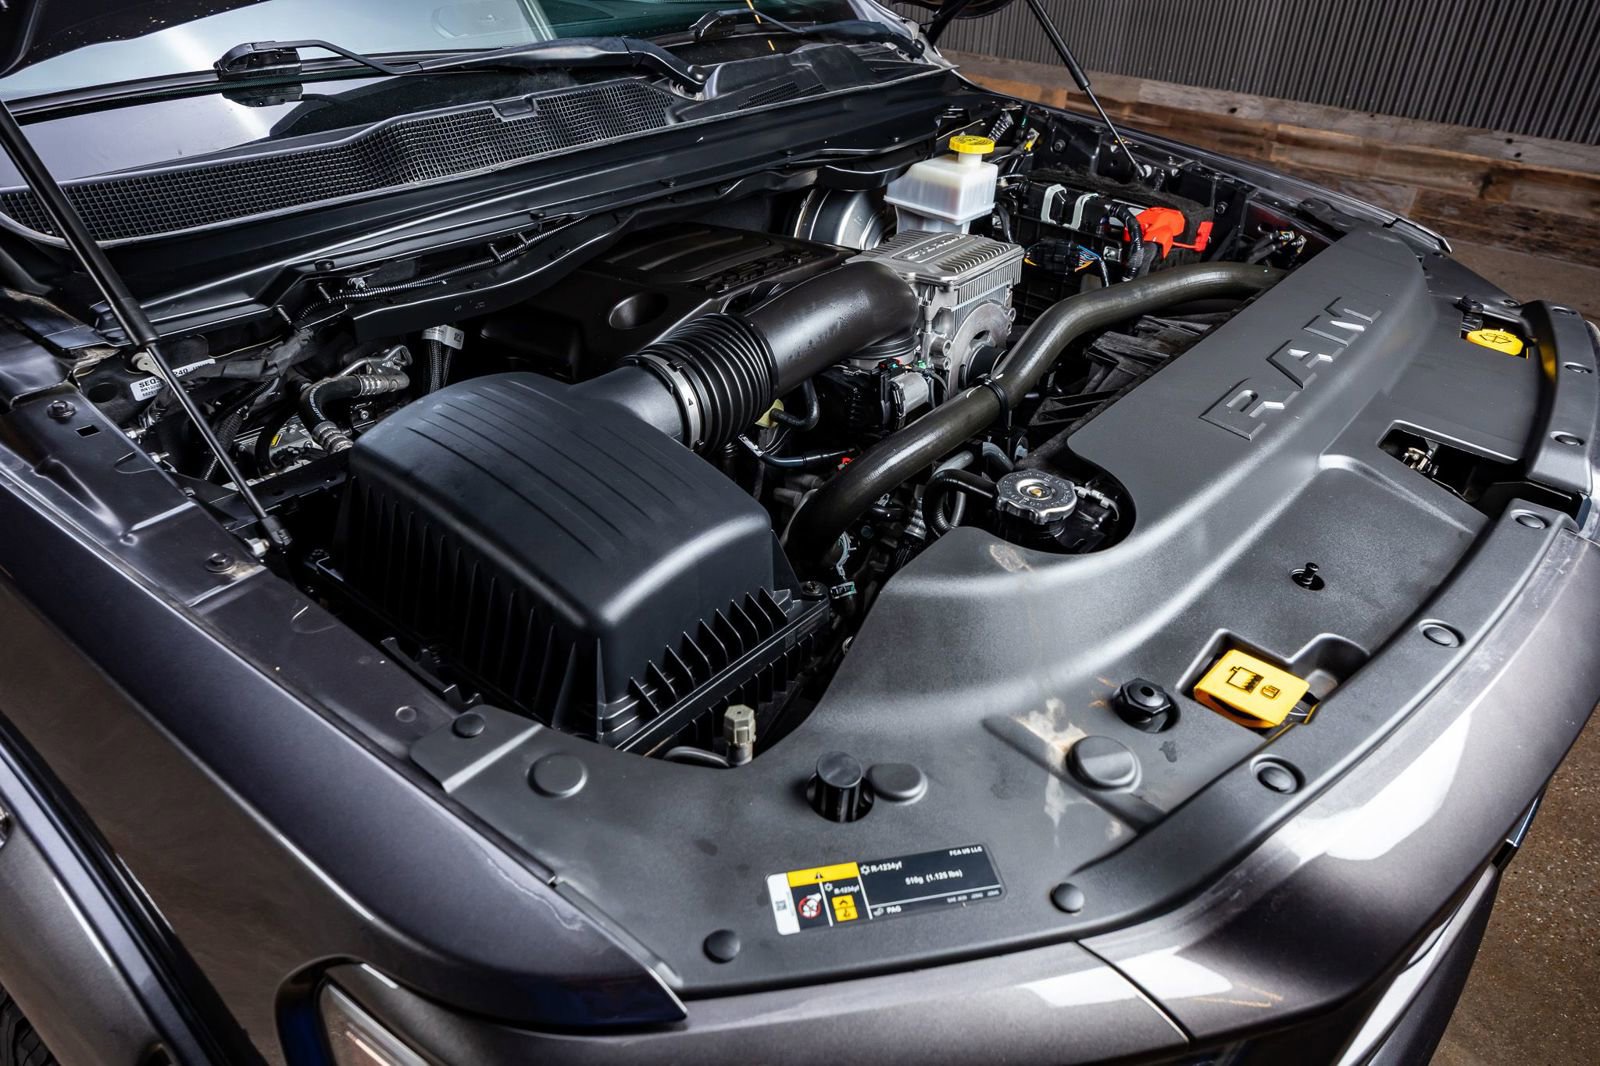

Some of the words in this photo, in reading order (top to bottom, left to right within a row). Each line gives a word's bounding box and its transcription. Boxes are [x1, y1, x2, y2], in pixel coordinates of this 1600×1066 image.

[1198, 296, 1382, 441] RAM
[870, 861, 903, 874] R-1234yf
[886, 906, 902, 914] PAG
